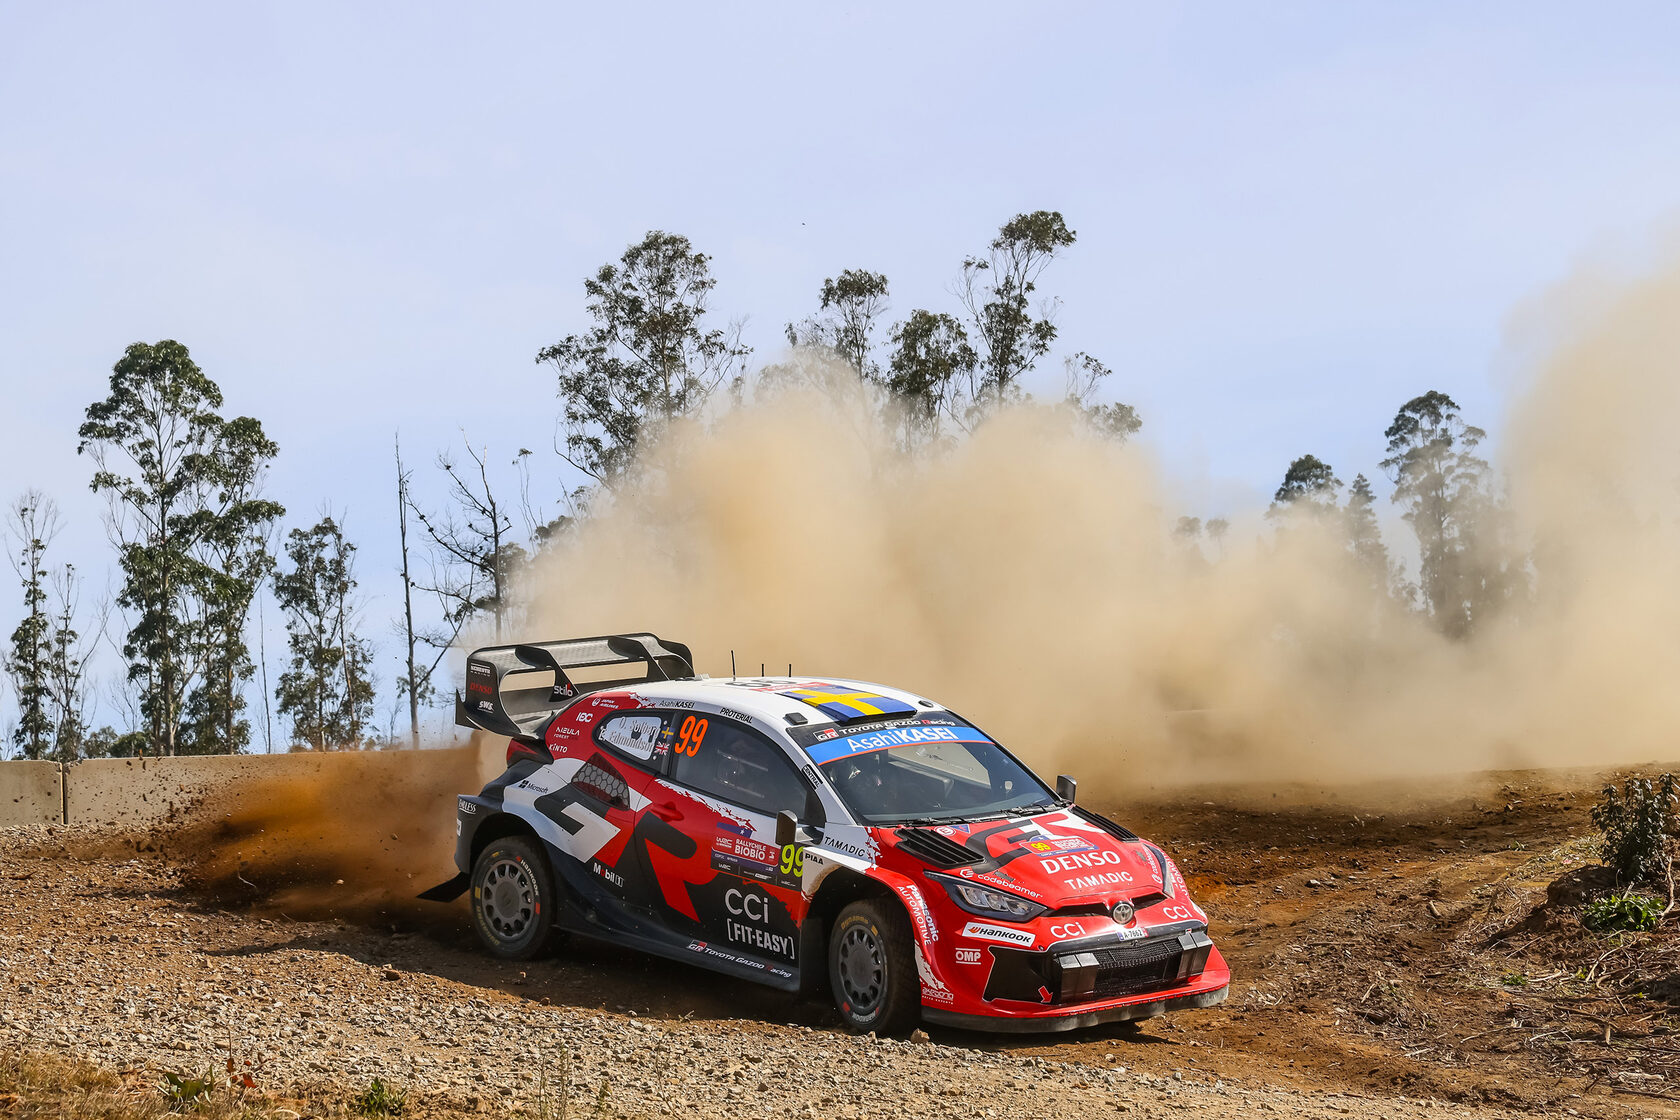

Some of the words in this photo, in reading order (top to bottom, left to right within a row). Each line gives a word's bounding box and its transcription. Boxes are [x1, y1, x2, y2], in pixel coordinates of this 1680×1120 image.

[554, 683, 573, 697] Stilo
[719, 707, 754, 724] PROTERIAL
[674, 715, 709, 757] 99
[816, 729, 840, 742] GR
[839, 723, 883, 735] TOYOTA
[884, 719, 921, 730] GAZOO
[921, 719, 956, 727] Racing
[846, 727, 959, 752] AsahiKASEI
[526, 783, 549, 794] Microsoft
[824, 836, 866, 857] TAMADIC
[1030, 842, 1052, 851] 99
[780, 844, 803, 878] 99
[805, 852, 824, 865] PIAA
[1039, 851, 1121, 874] DENSO
[977, 873, 1043, 899] codebeamer
[1064, 871, 1133, 891] TAMADIC
[725, 888, 769, 924] CCi
[896, 886, 931, 946] AUTOMOTIVE
[906, 884, 939, 942] Panasonic
[687, 941, 706, 953] GR
[704, 947, 736, 961] TOYOTA
[735, 957, 765, 969] GAZOO
[764, 963, 792, 978] Racing
[955, 951, 981, 962] OMP
